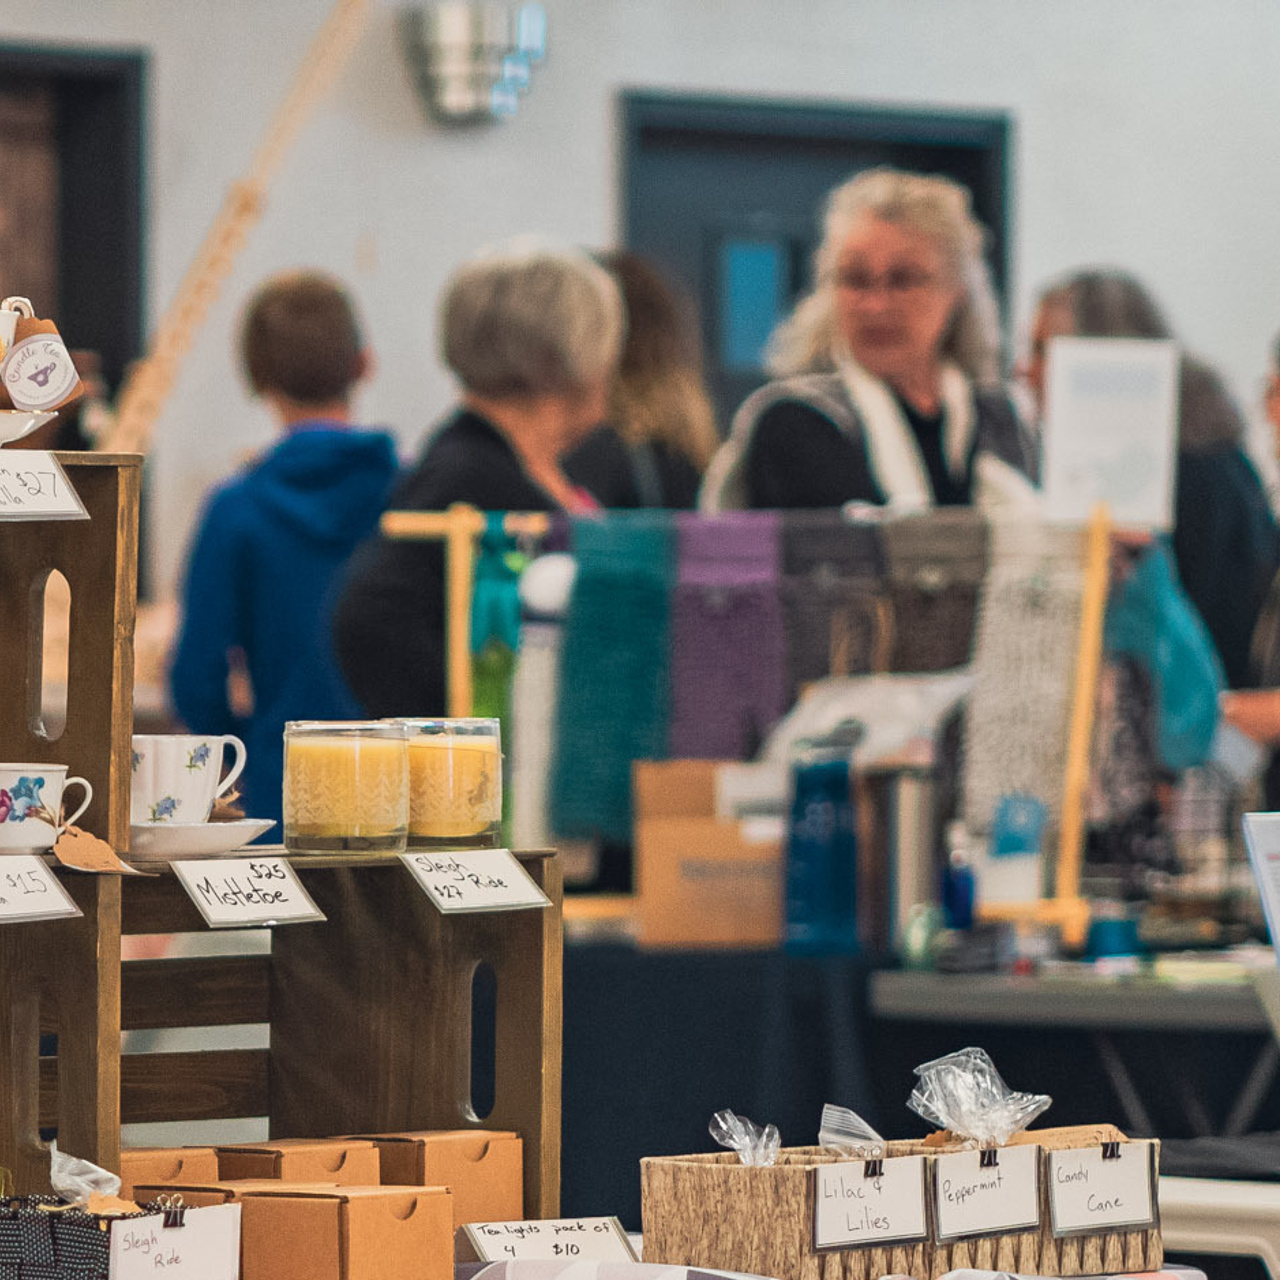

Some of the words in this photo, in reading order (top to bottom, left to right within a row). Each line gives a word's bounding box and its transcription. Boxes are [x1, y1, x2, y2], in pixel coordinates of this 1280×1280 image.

[14, 471, 58, 498] $27
[249, 862, 287, 880] $25
[414, 855, 468, 881] Sleigh
[5, 870, 48, 895] $15
[196, 876, 290, 907] Mistletoe
[433, 883, 464, 899] $27
[466, 872, 508, 890] Ride
[1056, 1165, 1090, 1184] Candy
[823, 1177, 866, 1200] Lilac
[942, 1170, 1004, 1206] Peppermint
[1087, 1193, 1123, 1213] Cane
[847, 1206, 891, 1232] Lilies
[476, 1224, 502, 1236] Tea
[505, 1224, 541, 1239] lights
[551, 1222, 587, 1235] pack
[593, 1222, 610, 1234] of
[121, 1229, 159, 1255] Sleigh
[503, 1245, 516, 1257] 4
[552, 1243, 580, 1256] $10
[153, 1248, 183, 1270] Ride
